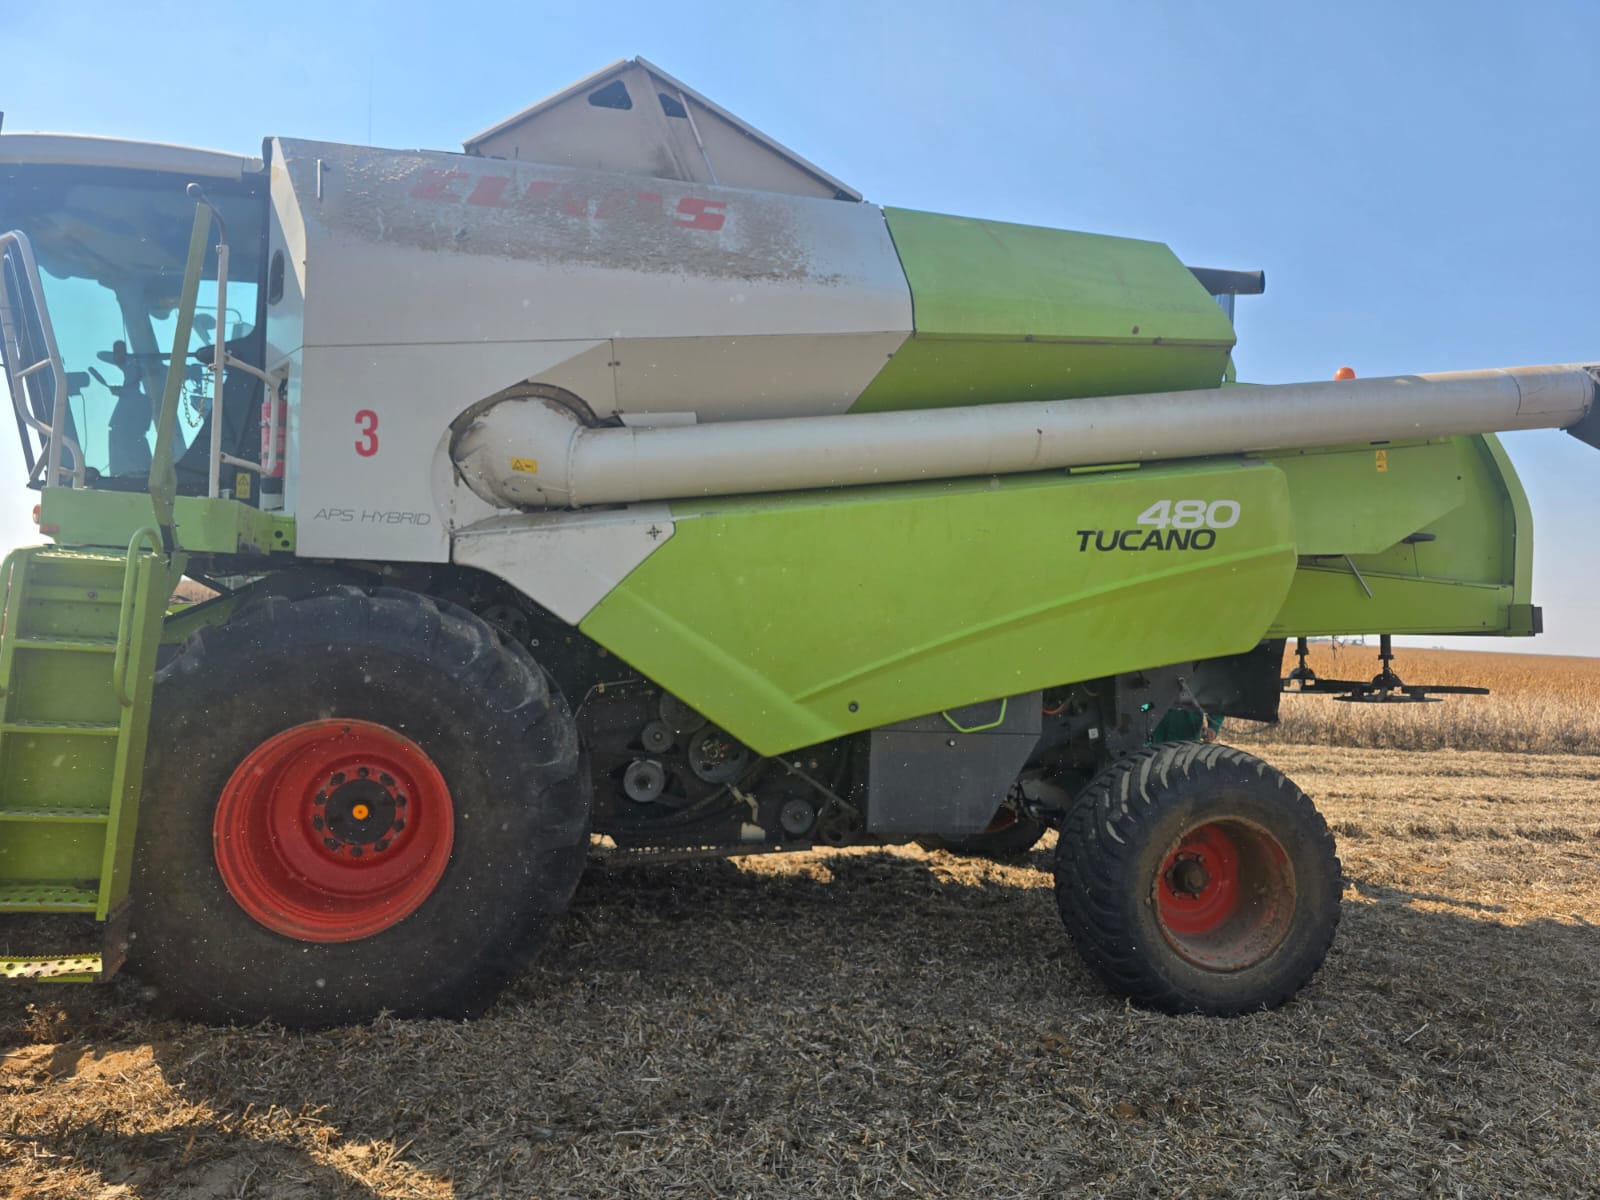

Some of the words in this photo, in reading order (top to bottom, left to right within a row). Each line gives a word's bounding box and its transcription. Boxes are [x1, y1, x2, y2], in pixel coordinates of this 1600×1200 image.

[354, 409, 379, 457] 3
[314, 508, 355, 522] APS
[361, 511, 431, 526] HYBRID
[1136, 499, 1241, 530] 480
[1076, 529, 1217, 552] TUCANO
